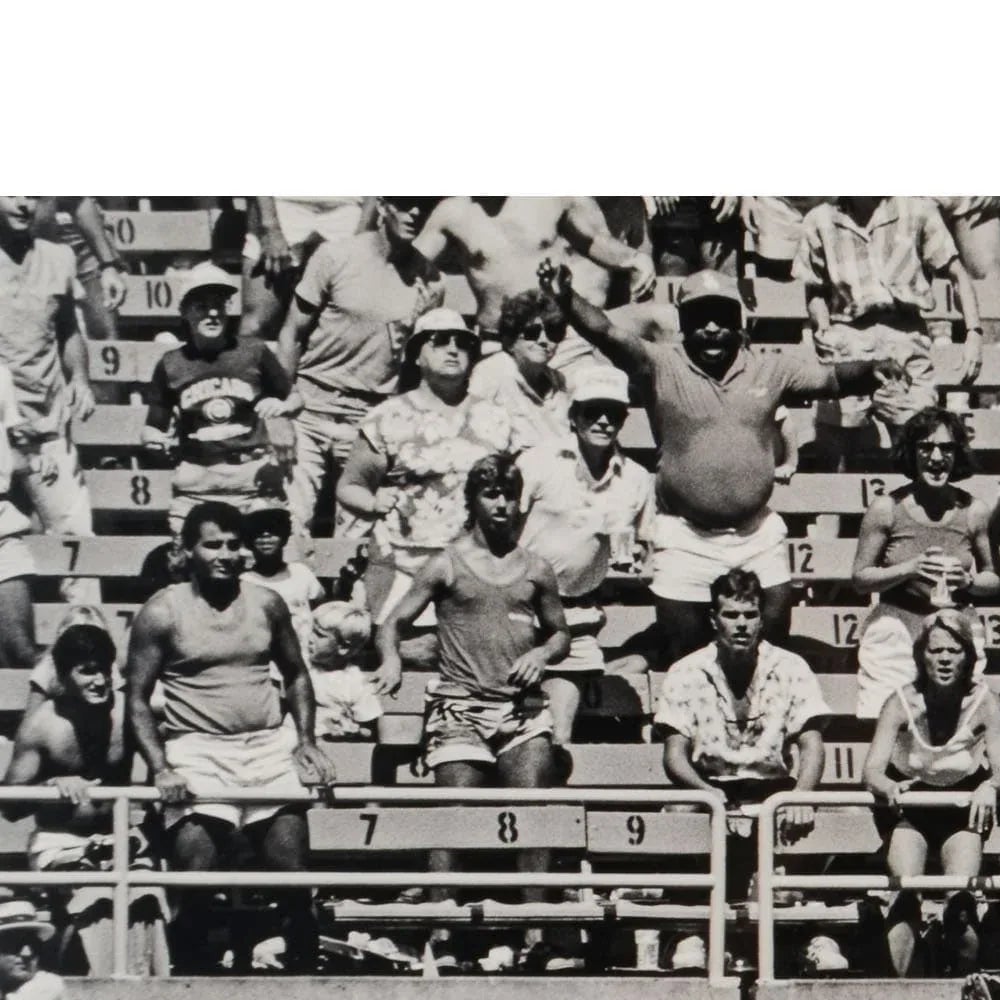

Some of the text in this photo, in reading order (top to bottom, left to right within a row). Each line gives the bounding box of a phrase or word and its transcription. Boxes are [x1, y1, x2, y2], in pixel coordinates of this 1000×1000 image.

[146, 280, 173, 309] 10
[101, 346, 121, 376] 9
[130, 475, 151, 506] 8
[62, 541, 81, 572] 7
[787, 543, 815, 574] 12
[834, 614, 860, 645] 12
[835, 747, 854, 779] 11
[359, 813, 379, 847] 7
[497, 811, 519, 844] 8
[626, 815, 646, 846] 9
